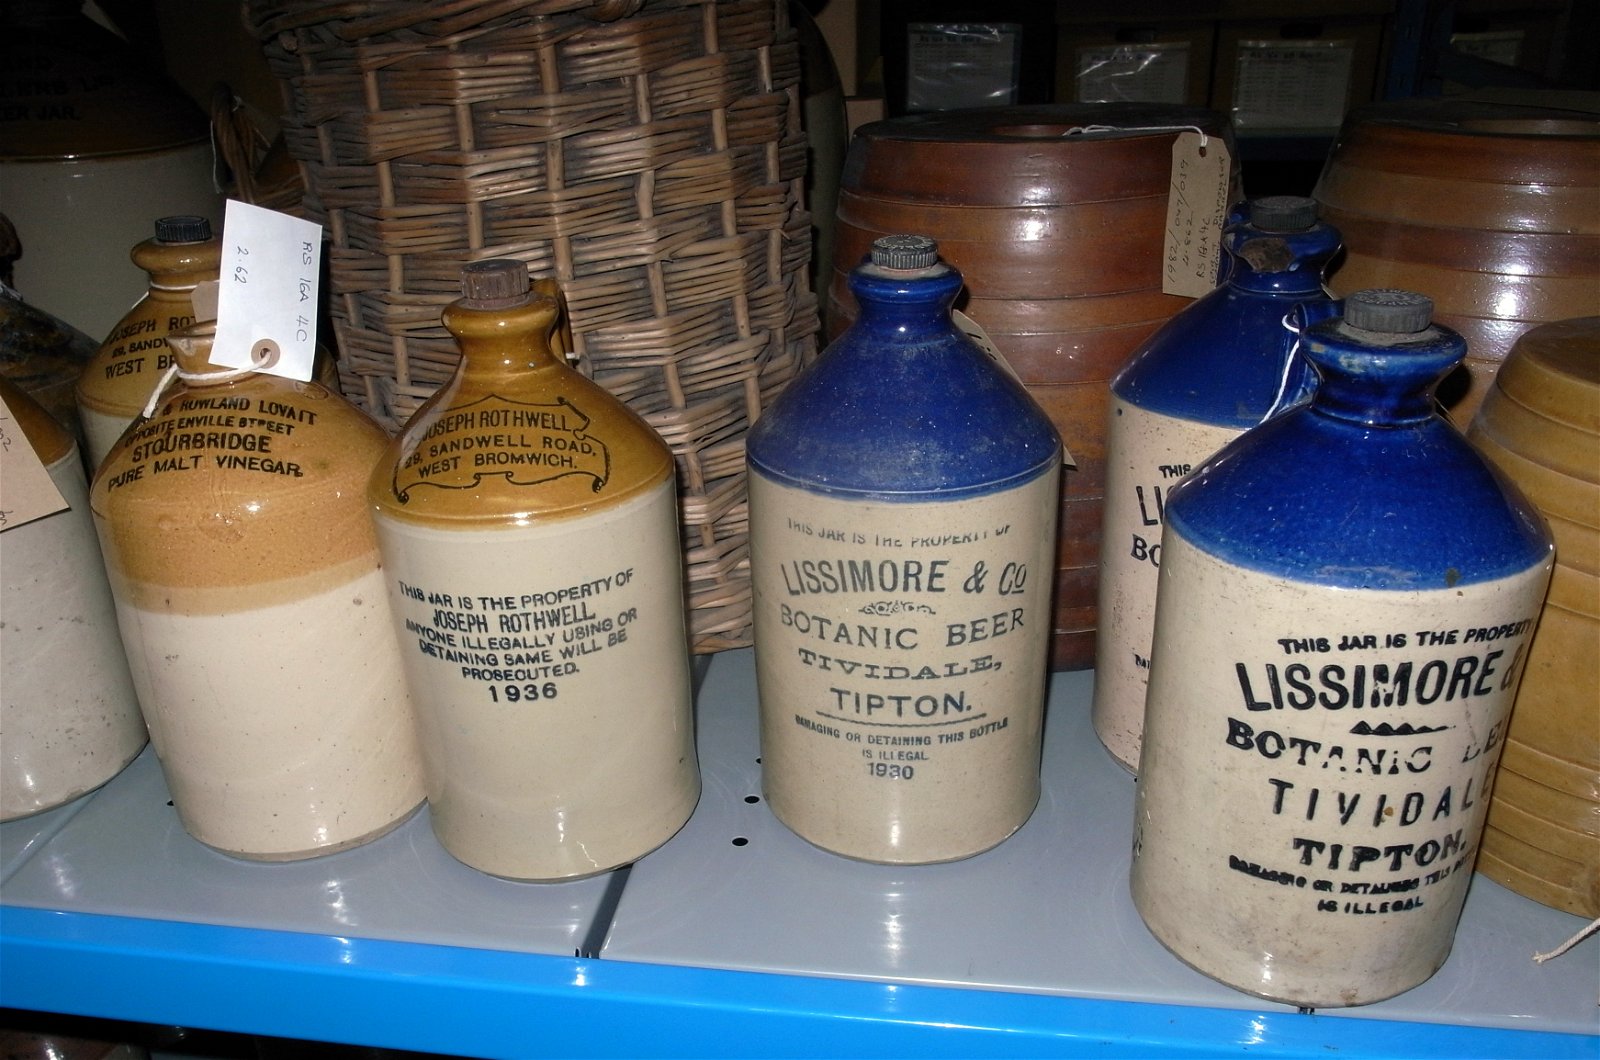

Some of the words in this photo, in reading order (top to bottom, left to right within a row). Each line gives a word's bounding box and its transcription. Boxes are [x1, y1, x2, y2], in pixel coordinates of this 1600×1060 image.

[302, 241, 313, 266] RS
[299, 277, 312, 303] 16A
[296, 315, 309, 342] 4C
[105, 357, 145, 379] WEST
[176, 414, 236, 430] ENVILLE
[422, 411, 475, 442] JOSEPH
[479, 408, 573, 432] ROTHWELL
[131, 430, 273, 464] STOURBRIDGE
[429, 434, 532, 458] SANDWELL
[107, 464, 146, 494] PURE
[153, 454, 204, 475] MALT
[417, 455, 462, 479] WEST
[473, 451, 578, 469] BROMWICH.
[398, 580, 426, 603] THIS
[427, 592, 455, 608] JAR
[457, 596, 474, 610] IS
[477, 596, 518, 611] THE
[520, 576, 612, 609] PROPERTY
[615, 567, 634, 587] OF
[780, 559, 950, 597] LISSIMORE
[962, 560, 989, 595] &
[405, 617, 458, 648] ANYONE
[461, 631, 556, 652] ILLEGALLY
[562, 617, 614, 644] USING
[616, 606, 638, 628] OR
[432, 607, 489, 634] JOSEPH
[498, 600, 597, 634] ROTHWELL
[780, 603, 919, 650] BOTANIC
[945, 607, 1025, 648] BEER
[418, 638, 500, 668] DETAINING
[503, 649, 554, 668] SAME
[558, 638, 603, 660] WILL
[607, 627, 628, 649] BE
[1278, 637, 1330, 655] THIS
[1337, 634, 1378, 651] JAR
[1386, 633, 1408, 649] IS
[1414, 627, 1460, 647] THE
[460, 661, 581, 682] PROSECUTED.
[1235, 649, 1505, 712] LISSIMORE
[487, 682, 559, 703] 1936
[829, 687, 973, 718] TIPTON.
[846, 730, 862, 743] OR
[867, 733, 932, 746] DETAINING
[937, 731, 965, 745] THIS
[968, 716, 1010, 740] BOTTLE
[1225, 717, 1433, 775] BOTANIC
[862, 748, 873, 759] IS
[866, 761, 915, 781] 1930
